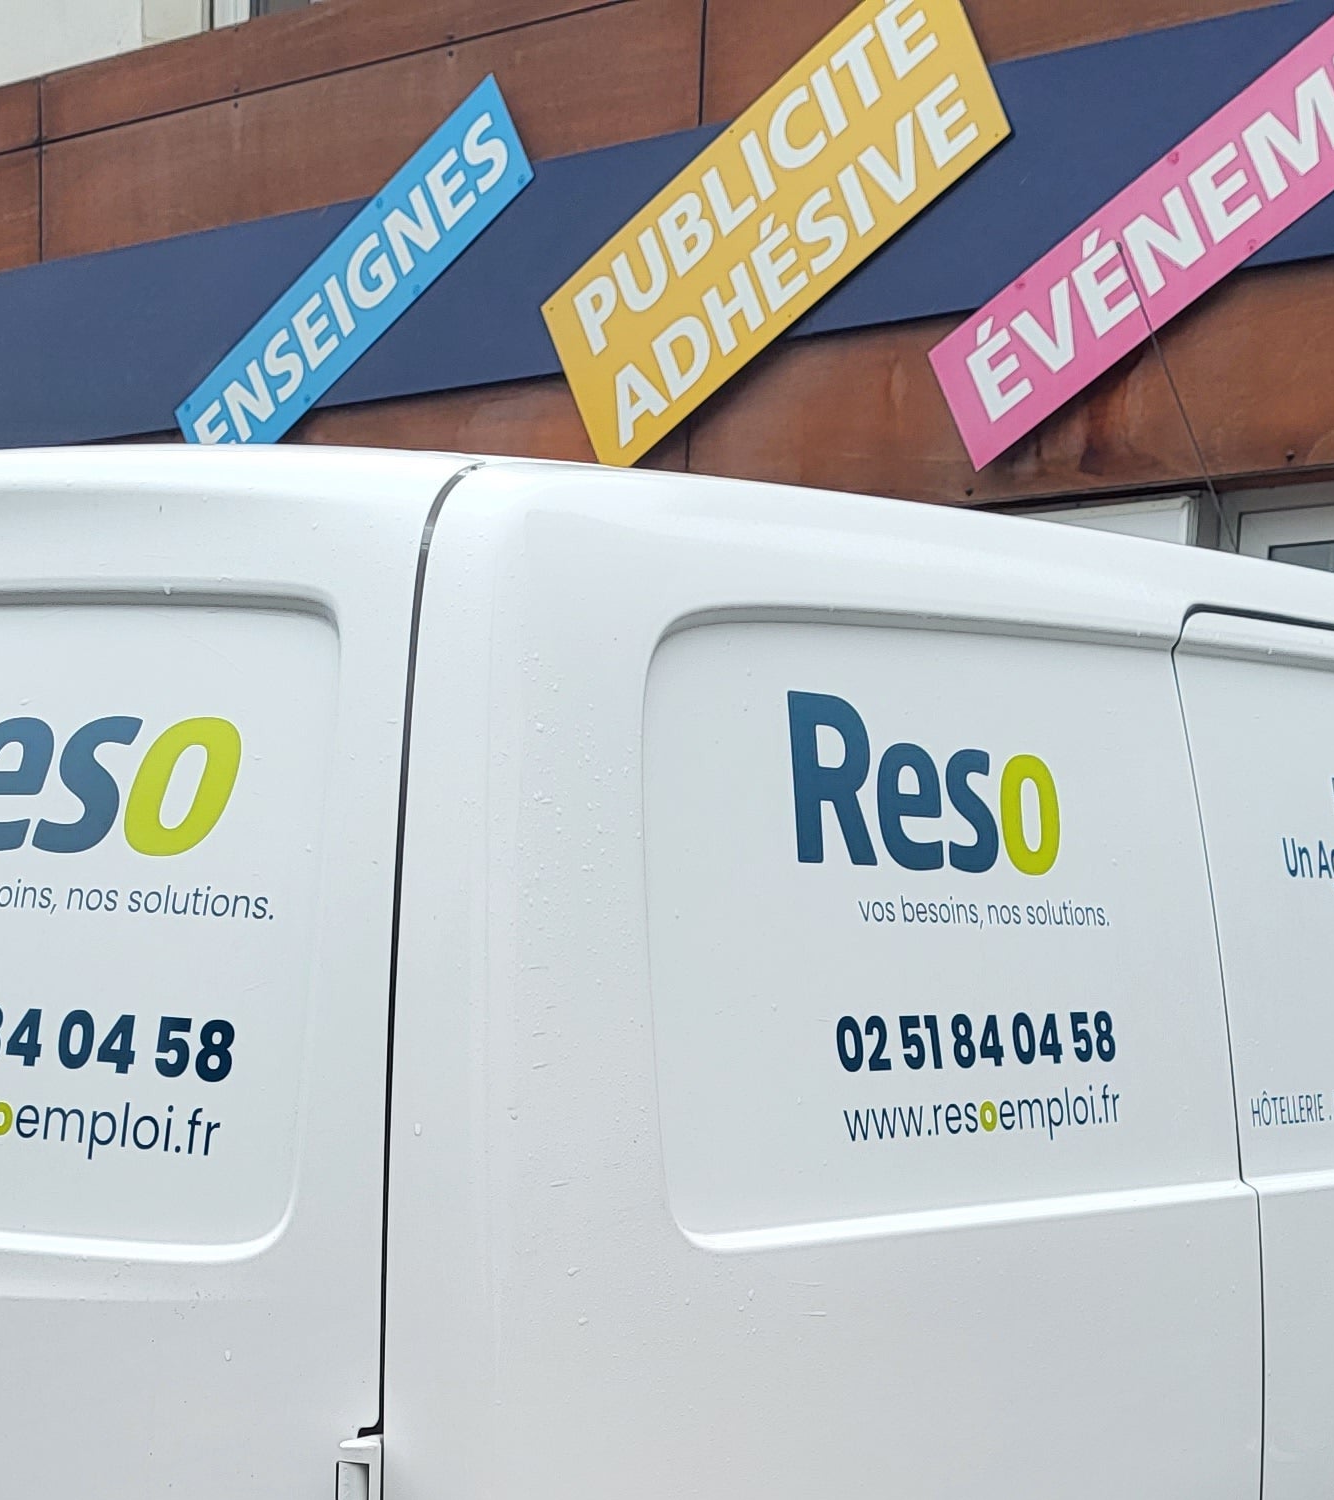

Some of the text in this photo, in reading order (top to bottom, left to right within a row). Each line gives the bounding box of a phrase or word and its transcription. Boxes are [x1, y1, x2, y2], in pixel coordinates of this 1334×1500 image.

[192, 112, 509, 444] ENSEIGNES
[613, 73, 980, 448] ADHÉSIVE
[787, 690, 1061, 876] Reso
[1282, 837, 1313, 879] Un
[67, 885, 118, 913] nos
[127, 884, 276, 922] solutions.
[858, 895, 1111, 930] vos besoins, nos solutions.
[57, 1008, 137, 1075] 04
[154, 1016, 236, 1084] 58
[835, 1010, 1117, 1073] 02 51 84 04 58
[843, 1083, 1120, 1142] www.resoemploi.fr
[1251, 1090, 1324, 1128] HÔTELLERIE
